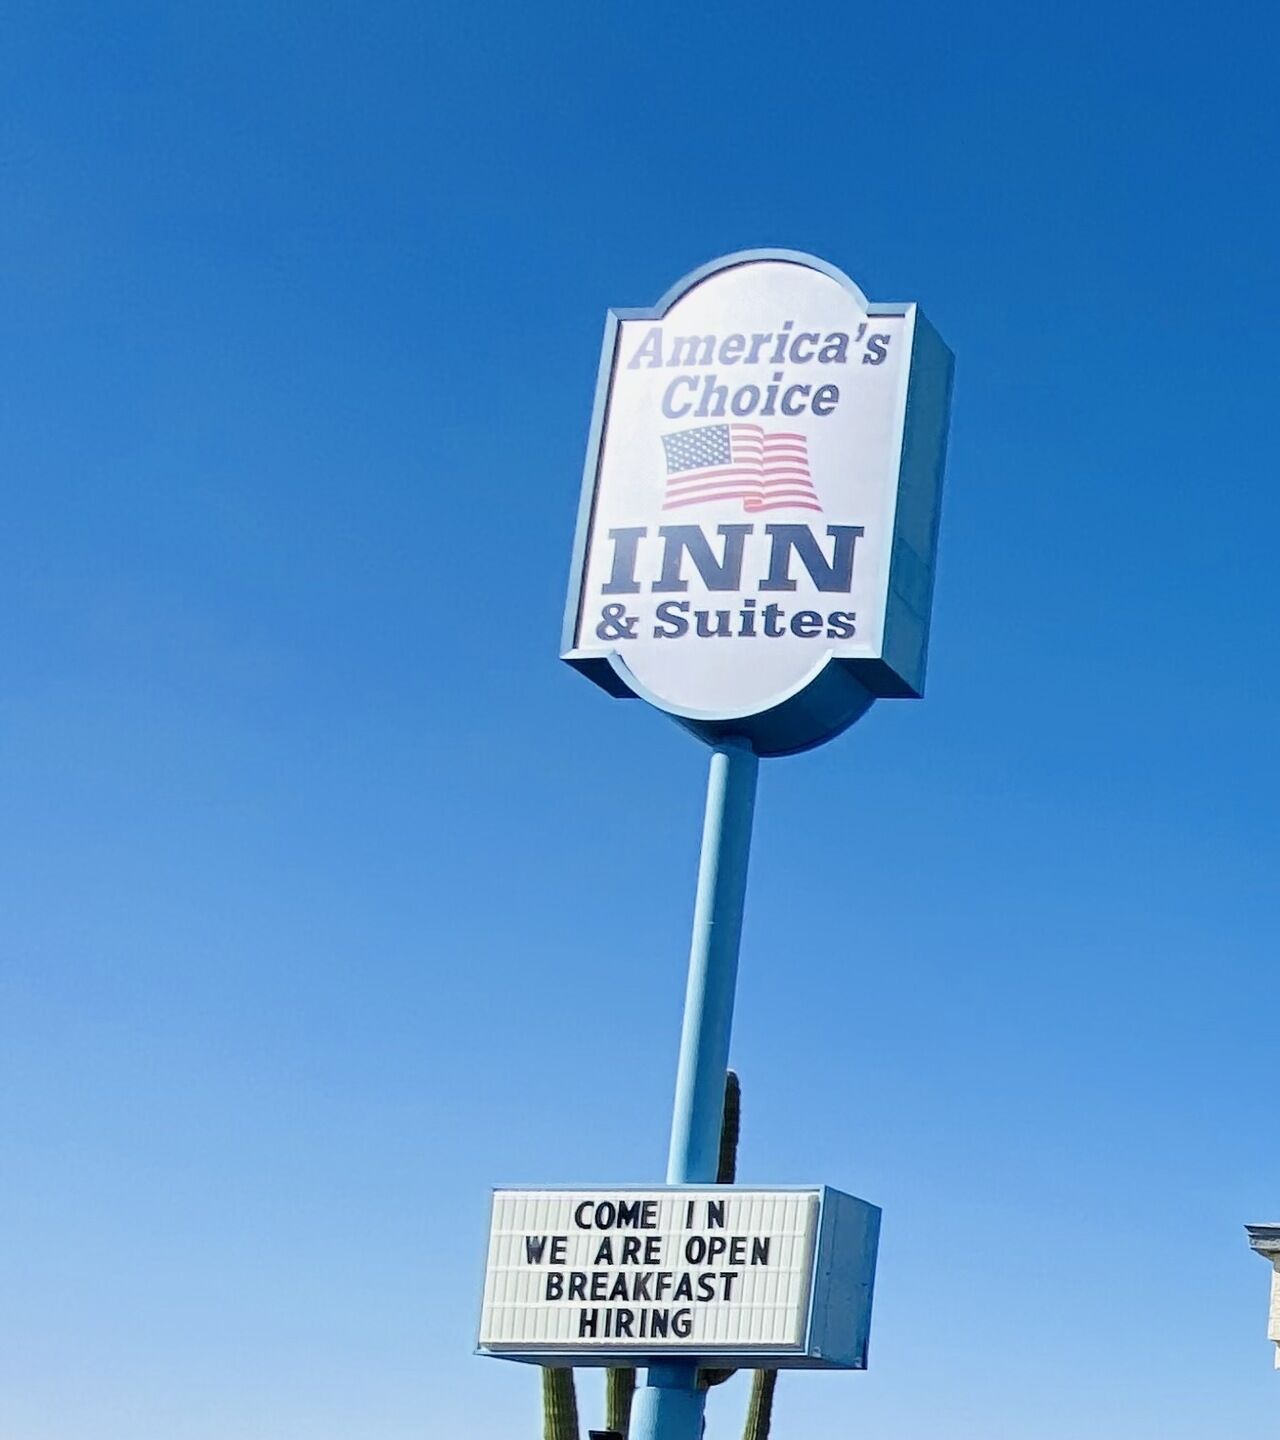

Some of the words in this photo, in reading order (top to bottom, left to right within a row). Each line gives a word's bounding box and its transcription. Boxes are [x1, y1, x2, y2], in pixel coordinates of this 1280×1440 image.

[626, 320, 891, 370] America's
[661, 372, 840, 419] Choice
[601, 524, 865, 595] INN
[595, 602, 638, 642] &
[653, 598, 857, 641] Suites
[574, 1200, 658, 1230] COME
[525, 1236, 568, 1266] WE
[594, 1236, 662, 1266] ARE
[685, 1236, 771, 1266] OPEN
[545, 1271, 738, 1302] BREAKFAST
[578, 1308, 692, 1338] HIRING
